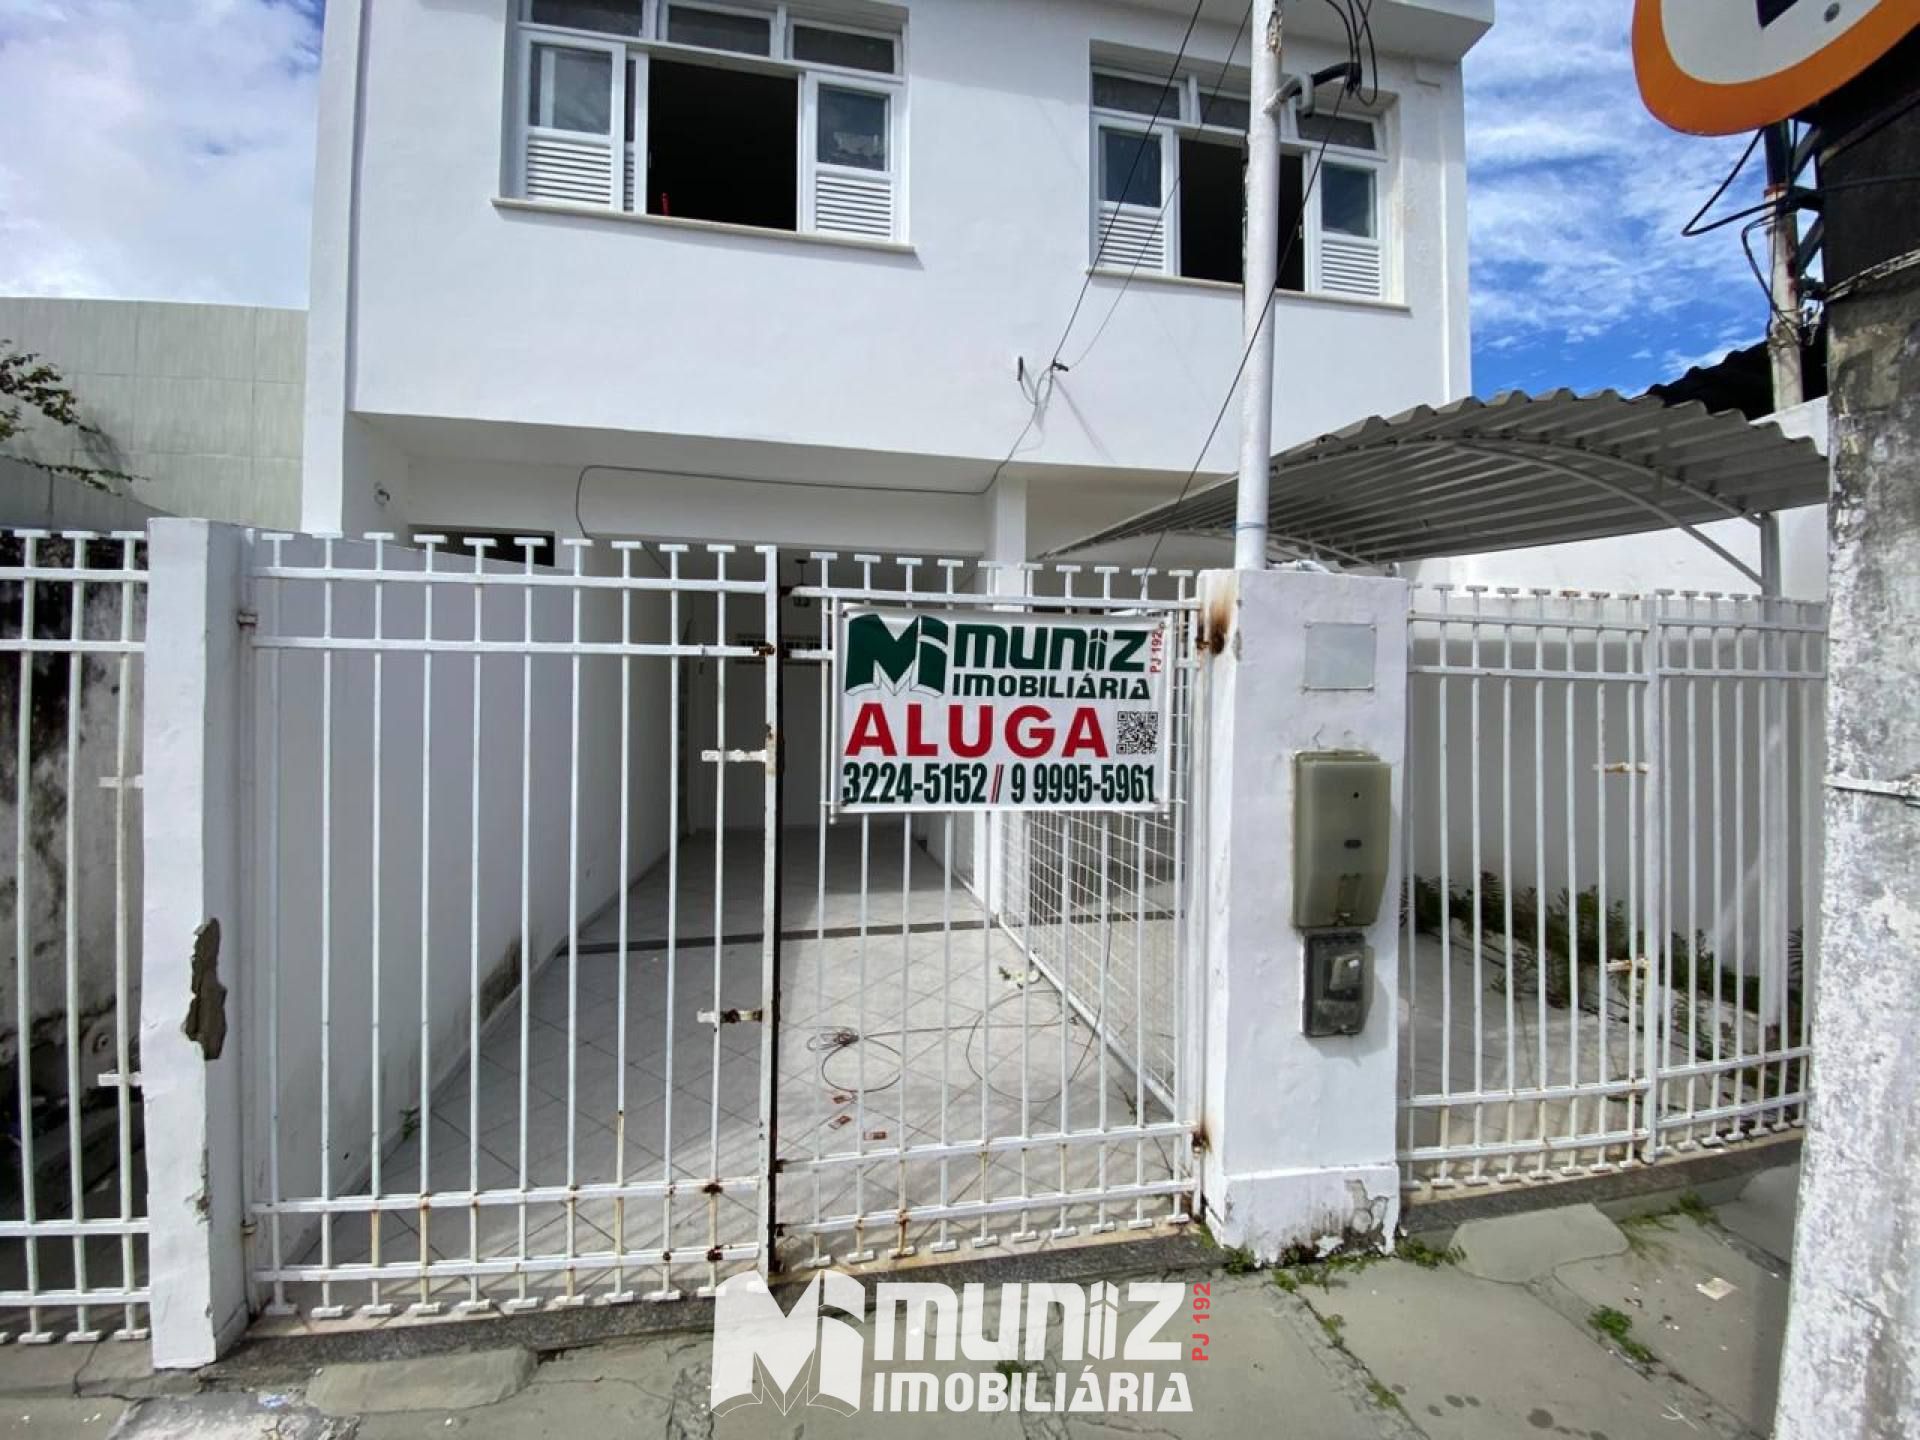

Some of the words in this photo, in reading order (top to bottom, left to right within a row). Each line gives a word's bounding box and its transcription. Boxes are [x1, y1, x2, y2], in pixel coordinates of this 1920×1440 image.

[1151, 630, 1163, 652] 192
[1150, 658, 1162, 673] PJ
[952, 673, 1151, 700] IMOBILIÁRIA
[844, 702, 1109, 759] ALUGA
[843, 762, 988, 805] 3224-5152
[1011, 764, 1026, 804] 9
[1033, 764, 1156, 805] 9995-5961
